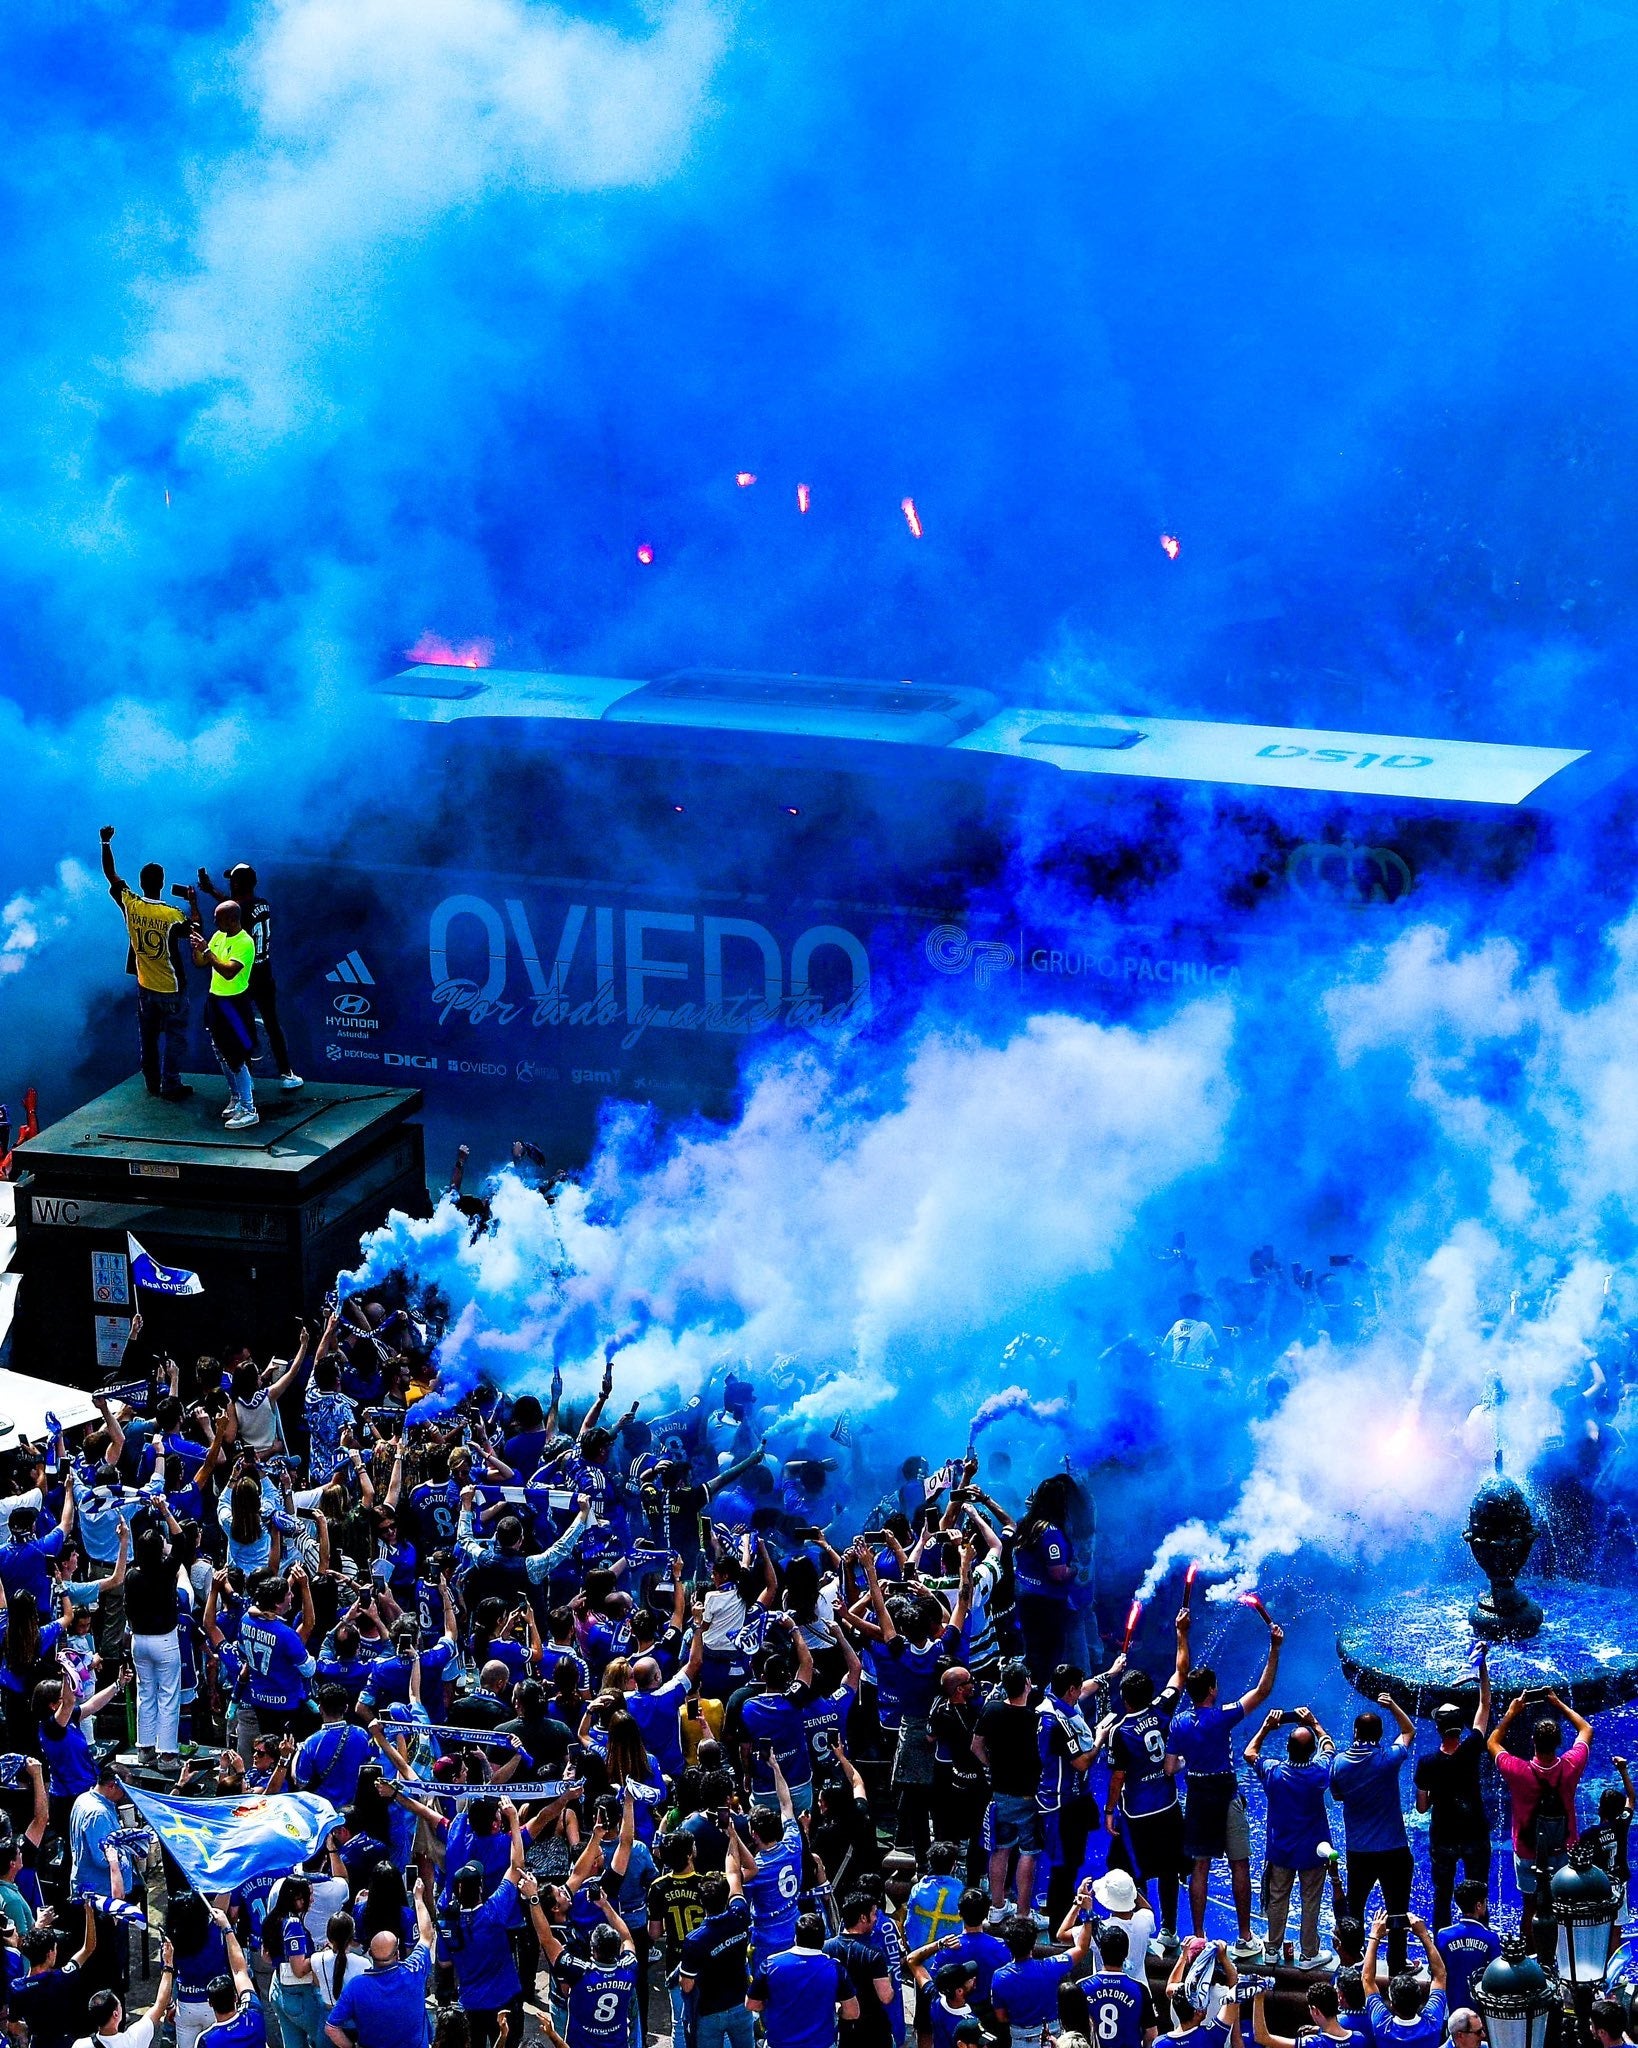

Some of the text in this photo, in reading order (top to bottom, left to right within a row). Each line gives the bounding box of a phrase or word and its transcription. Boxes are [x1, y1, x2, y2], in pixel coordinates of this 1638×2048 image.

[134, 928, 166, 960] 19
[429, 893, 871, 1041] OVIEDO
[1031, 948, 1243, 987] GRUPO PACHUCA
[431, 977, 524, 1027] Por
[529, 977, 627, 1027] todo
[781, 978, 874, 1030] tod
[325, 1015, 379, 1029] HYUNDAI
[336, 1029, 370, 1040] Asturdai
[383, 1053, 438, 1070] DIGI
[460, 1061, 507, 1076] OVIEDO
[36, 1199, 80, 1225] WC
[142, 1279, 161, 1289] Real
[256, 1629, 277, 1647] BENTO
[243, 1639, 273, 1676] 17
[803, 1712, 838, 1729] CERVERO
[1133, 1716, 1159, 1735] NAVES
[1144, 1729, 1165, 1763] 9
[1599, 1832, 1615, 1844] NICO
[256, 1876, 277, 1888] BER
[777, 1864, 798, 1898] 6
[664, 1888, 699, 1902] SEOANE
[881, 1921, 903, 1982] OVIEDO
[1447, 1937, 1489, 1953] REAL OVIEDO
[593, 1992, 619, 2022] 8
[1098, 2003, 1119, 2040] 8
